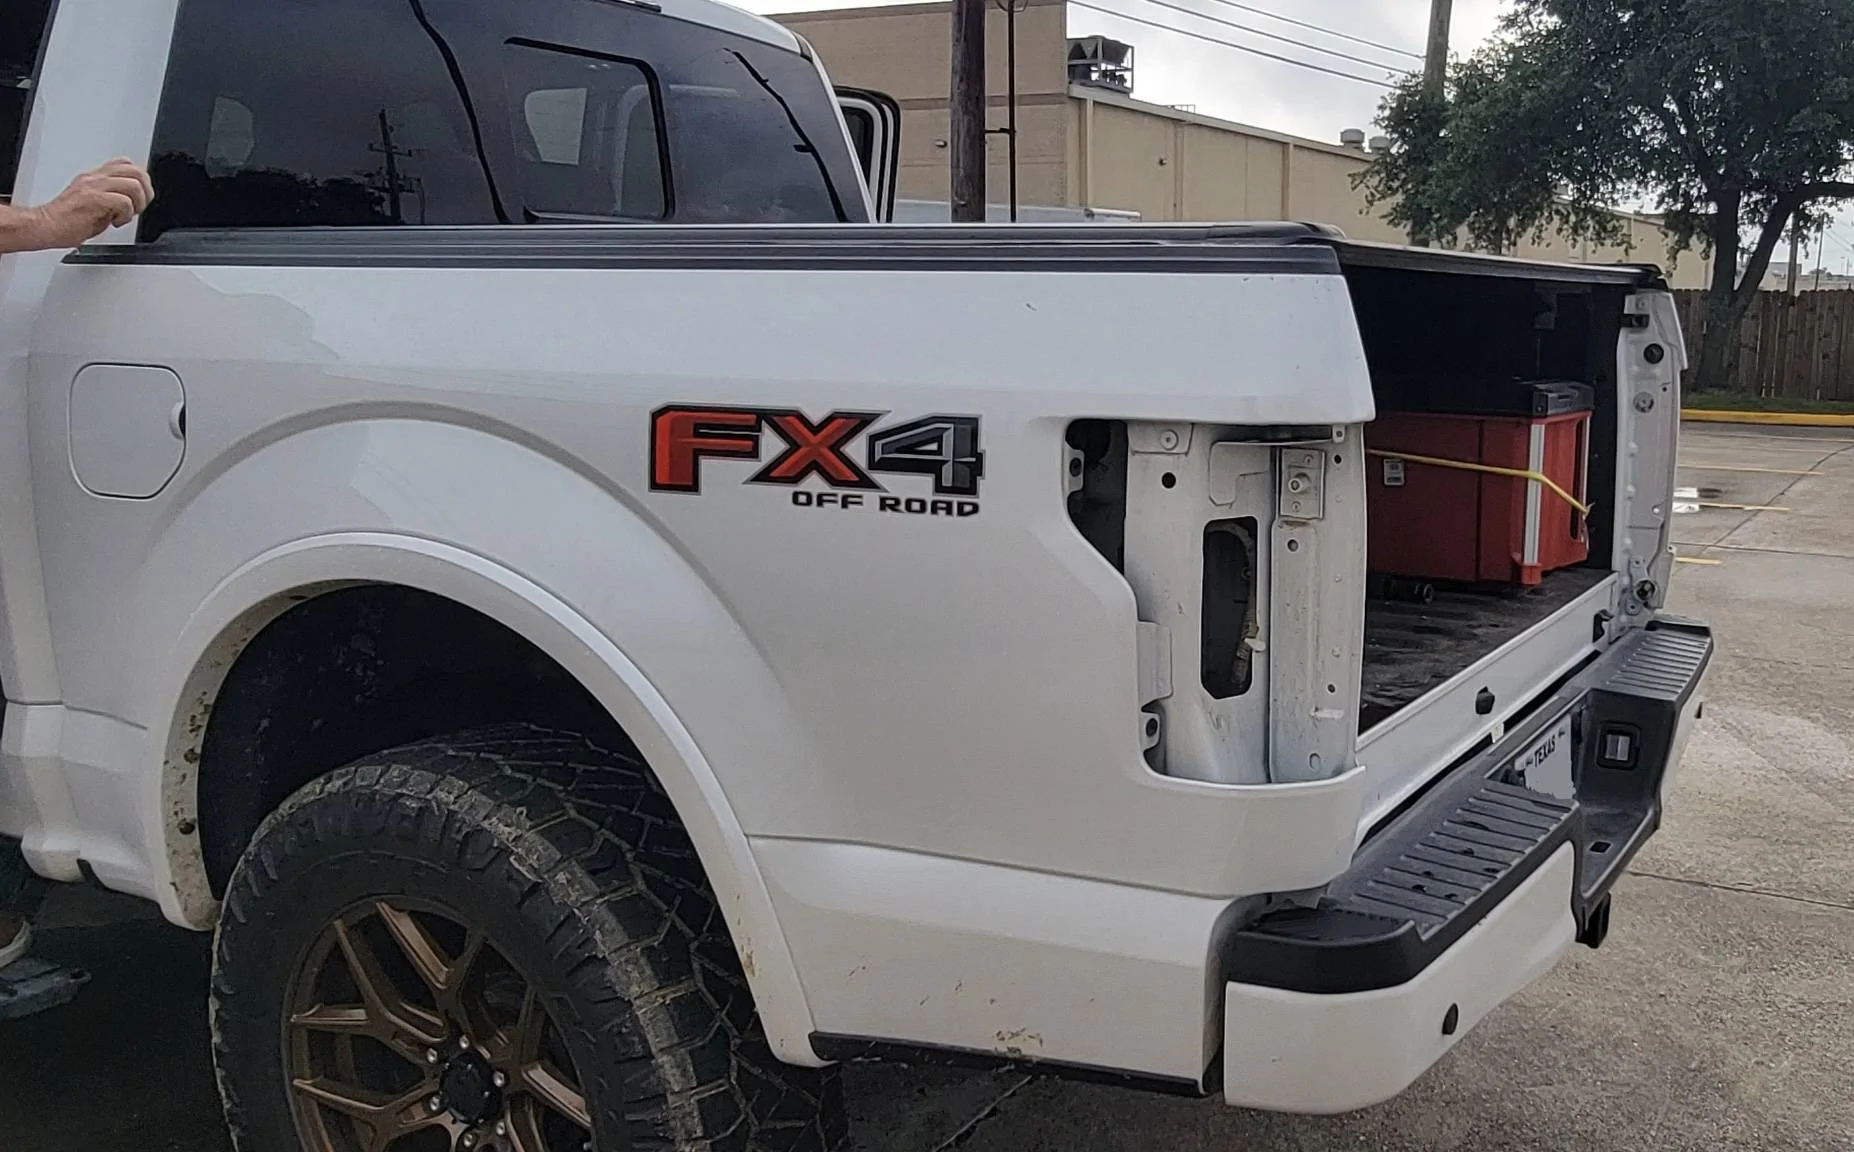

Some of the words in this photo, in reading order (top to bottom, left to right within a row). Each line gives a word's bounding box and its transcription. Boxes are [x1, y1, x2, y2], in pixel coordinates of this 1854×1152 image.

[648, 402, 985, 498] FX4
[792, 491, 864, 509] OFF
[879, 495, 980, 517] ROAD
[1534, 734, 1556, 768] TEXAS
